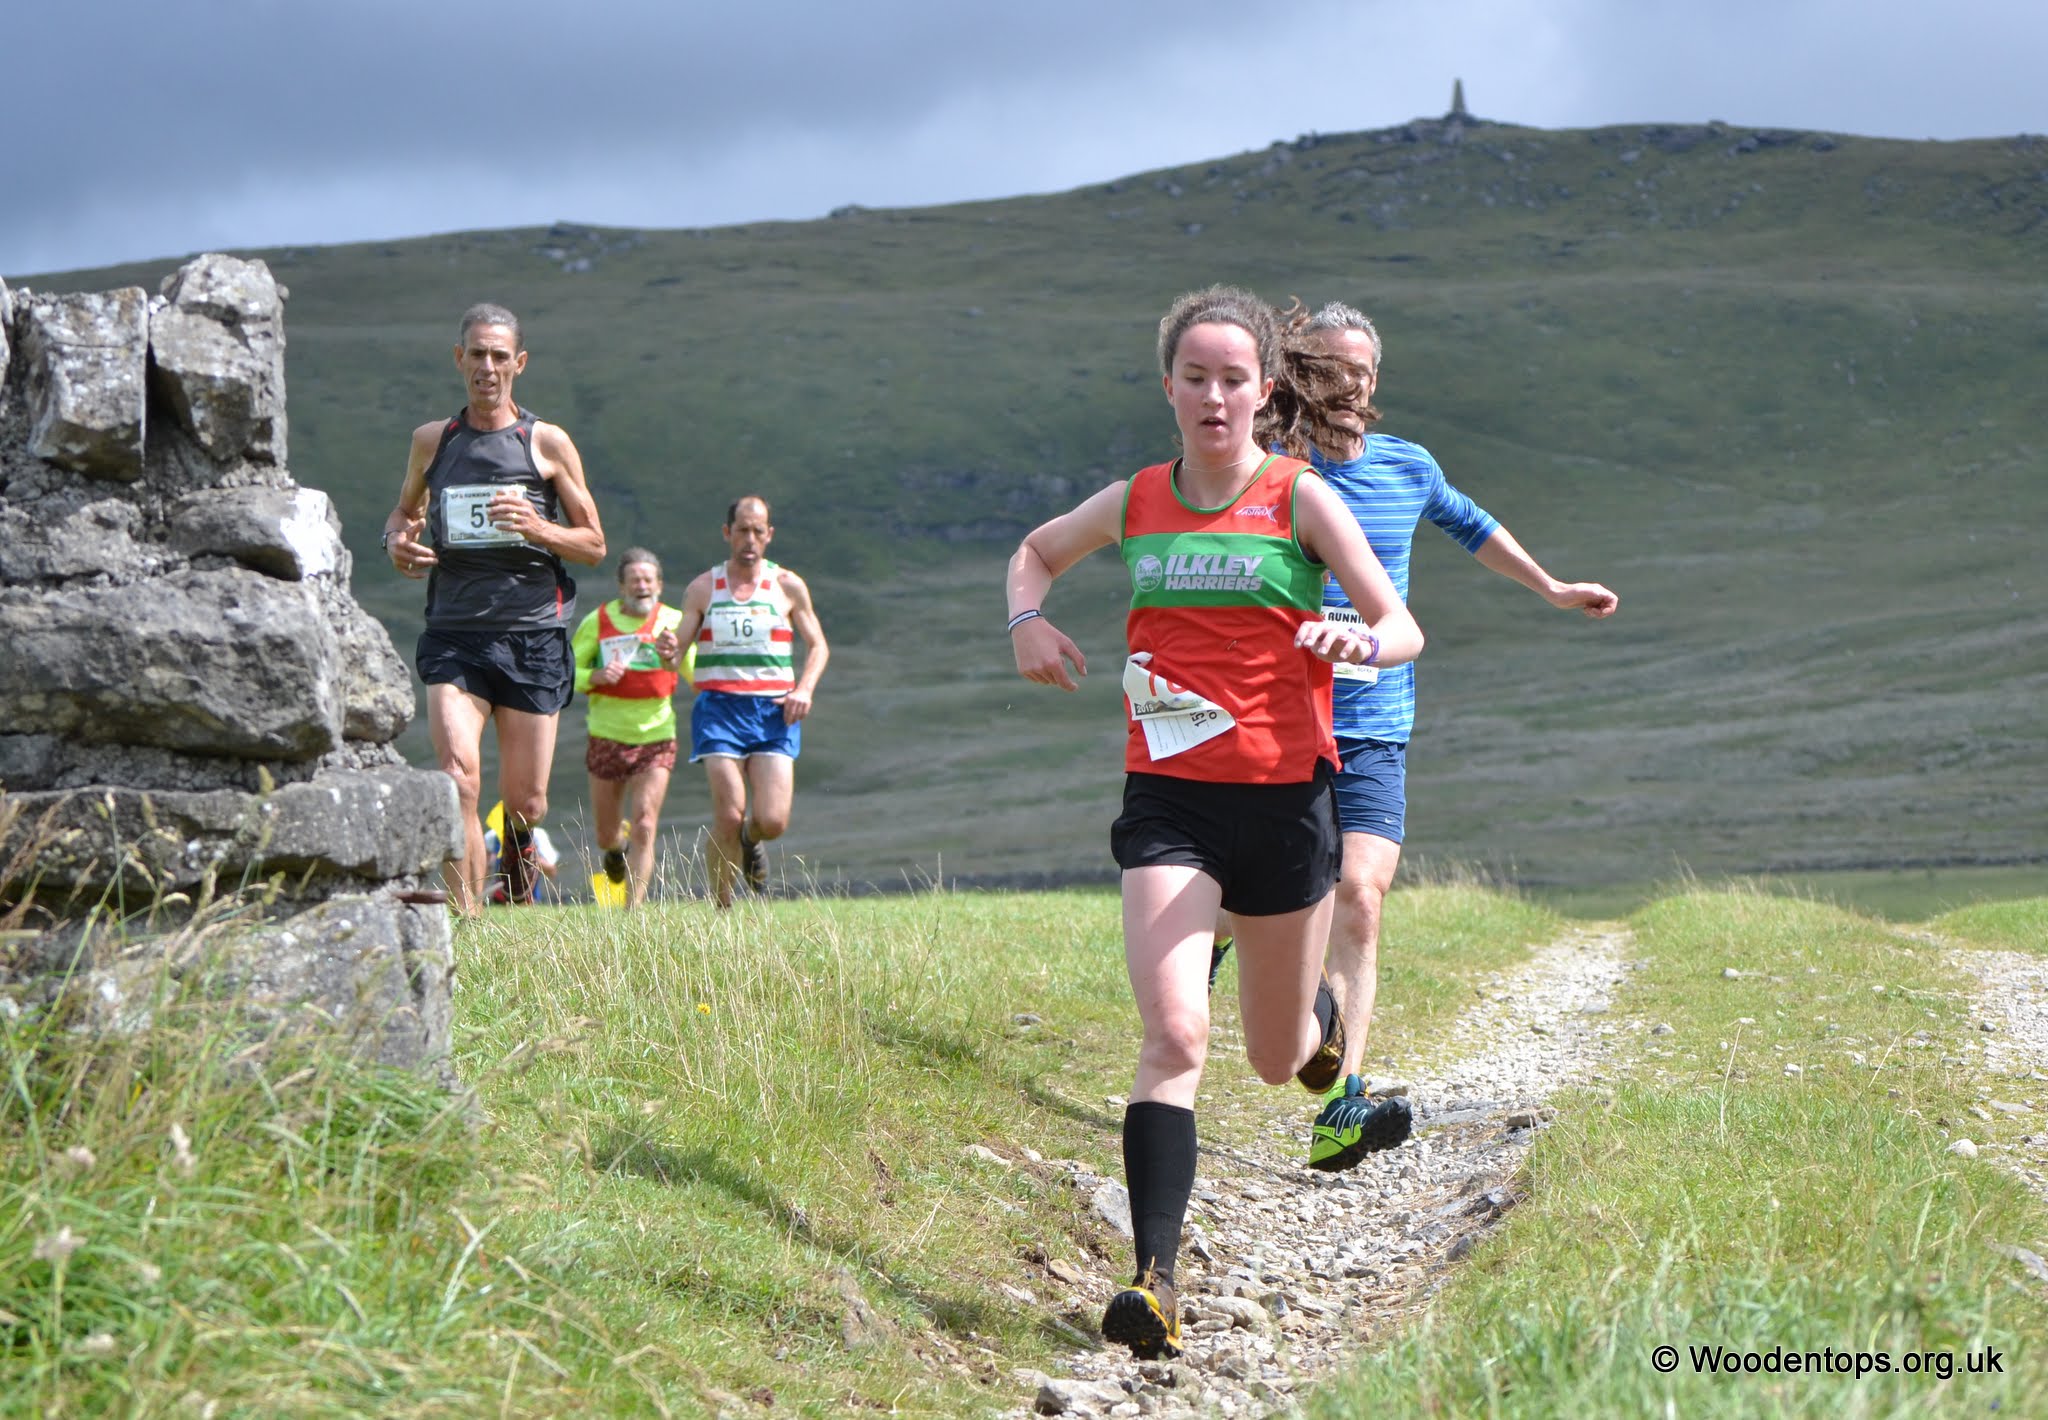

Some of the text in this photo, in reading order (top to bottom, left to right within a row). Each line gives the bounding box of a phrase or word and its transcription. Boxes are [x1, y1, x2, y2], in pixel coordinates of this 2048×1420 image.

[1164, 554, 1264, 576] ILKLEY
[1164, 575, 1264, 592] HARRIERS
[731, 619, 753, 637] 16
